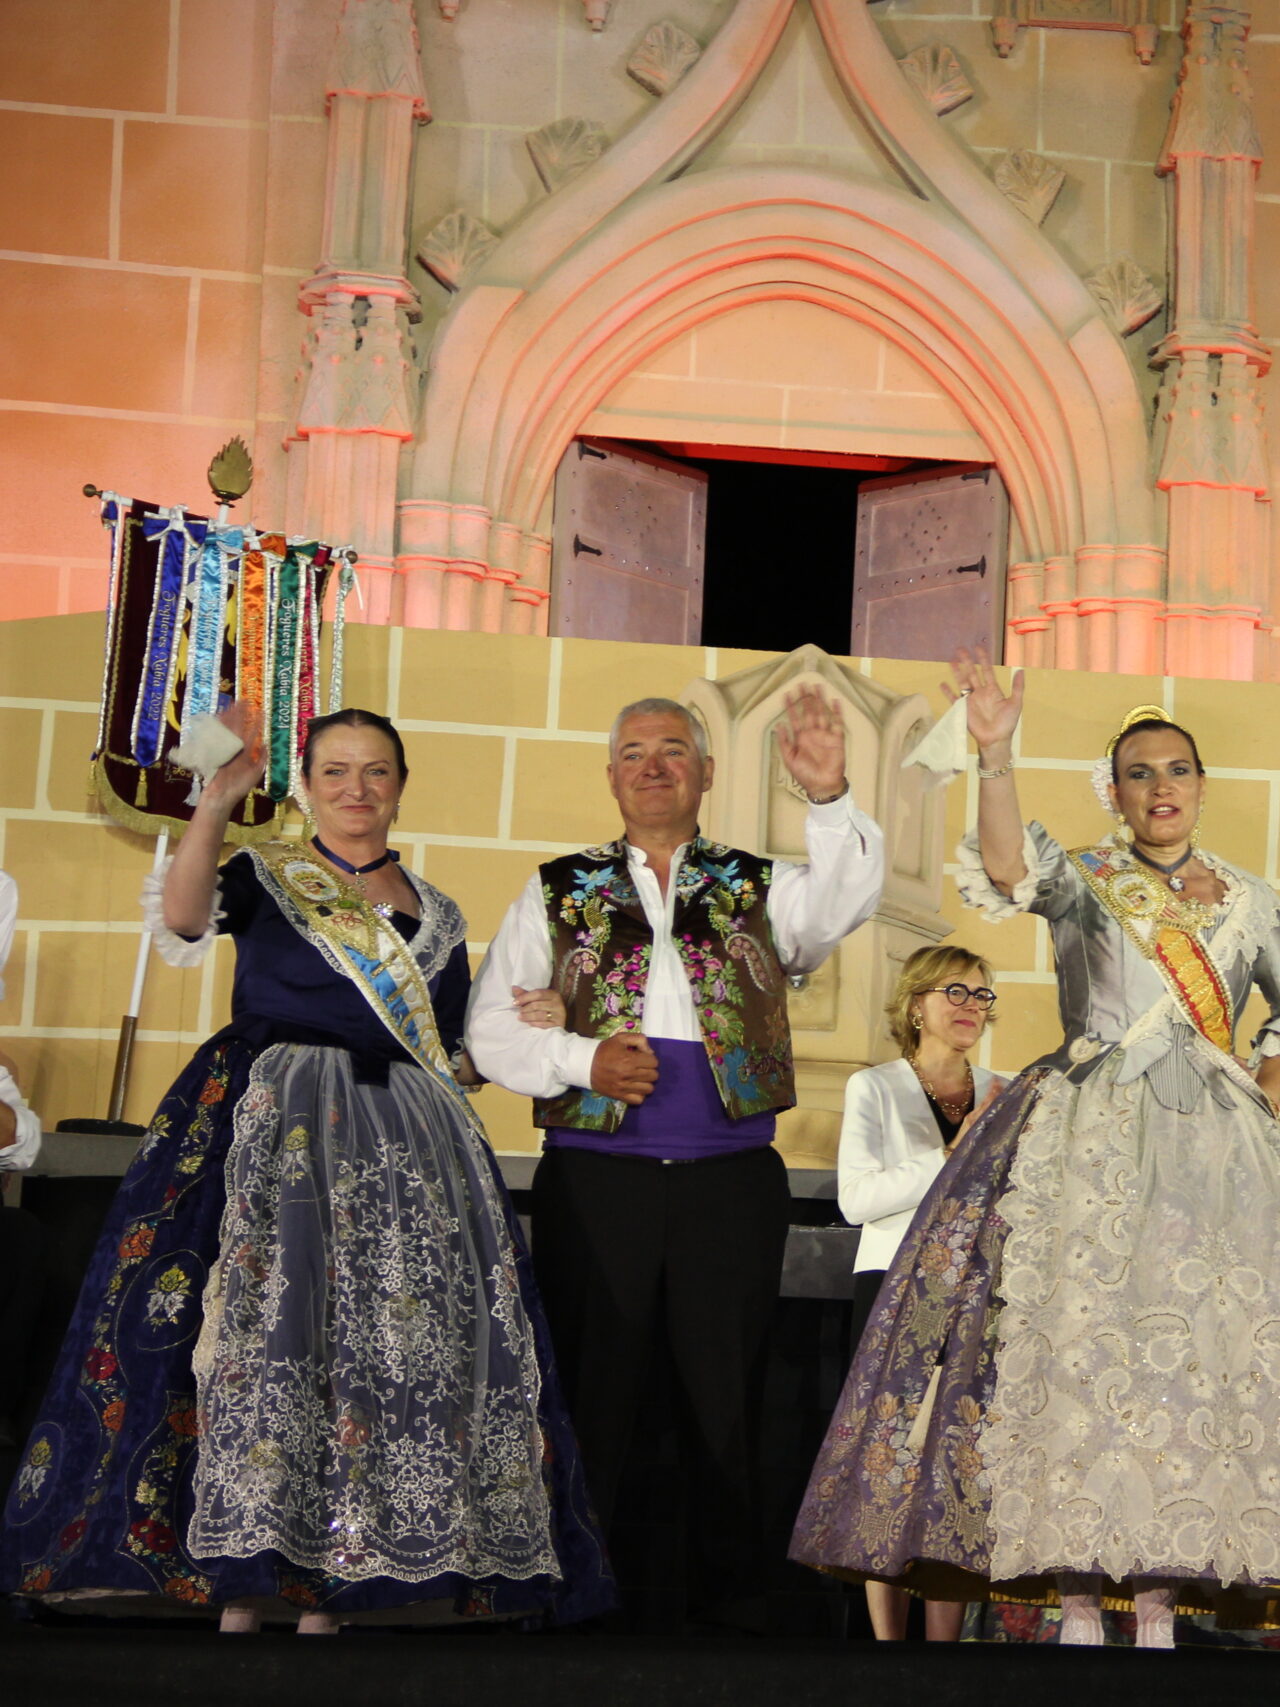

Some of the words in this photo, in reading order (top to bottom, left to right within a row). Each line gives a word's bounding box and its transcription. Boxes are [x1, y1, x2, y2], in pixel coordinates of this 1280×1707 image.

[158, 590, 177, 648] Fogueres
[279, 599, 296, 657] Fogueres
[147, 692, 163, 720] 2022
[277, 702, 290, 729] 2024
